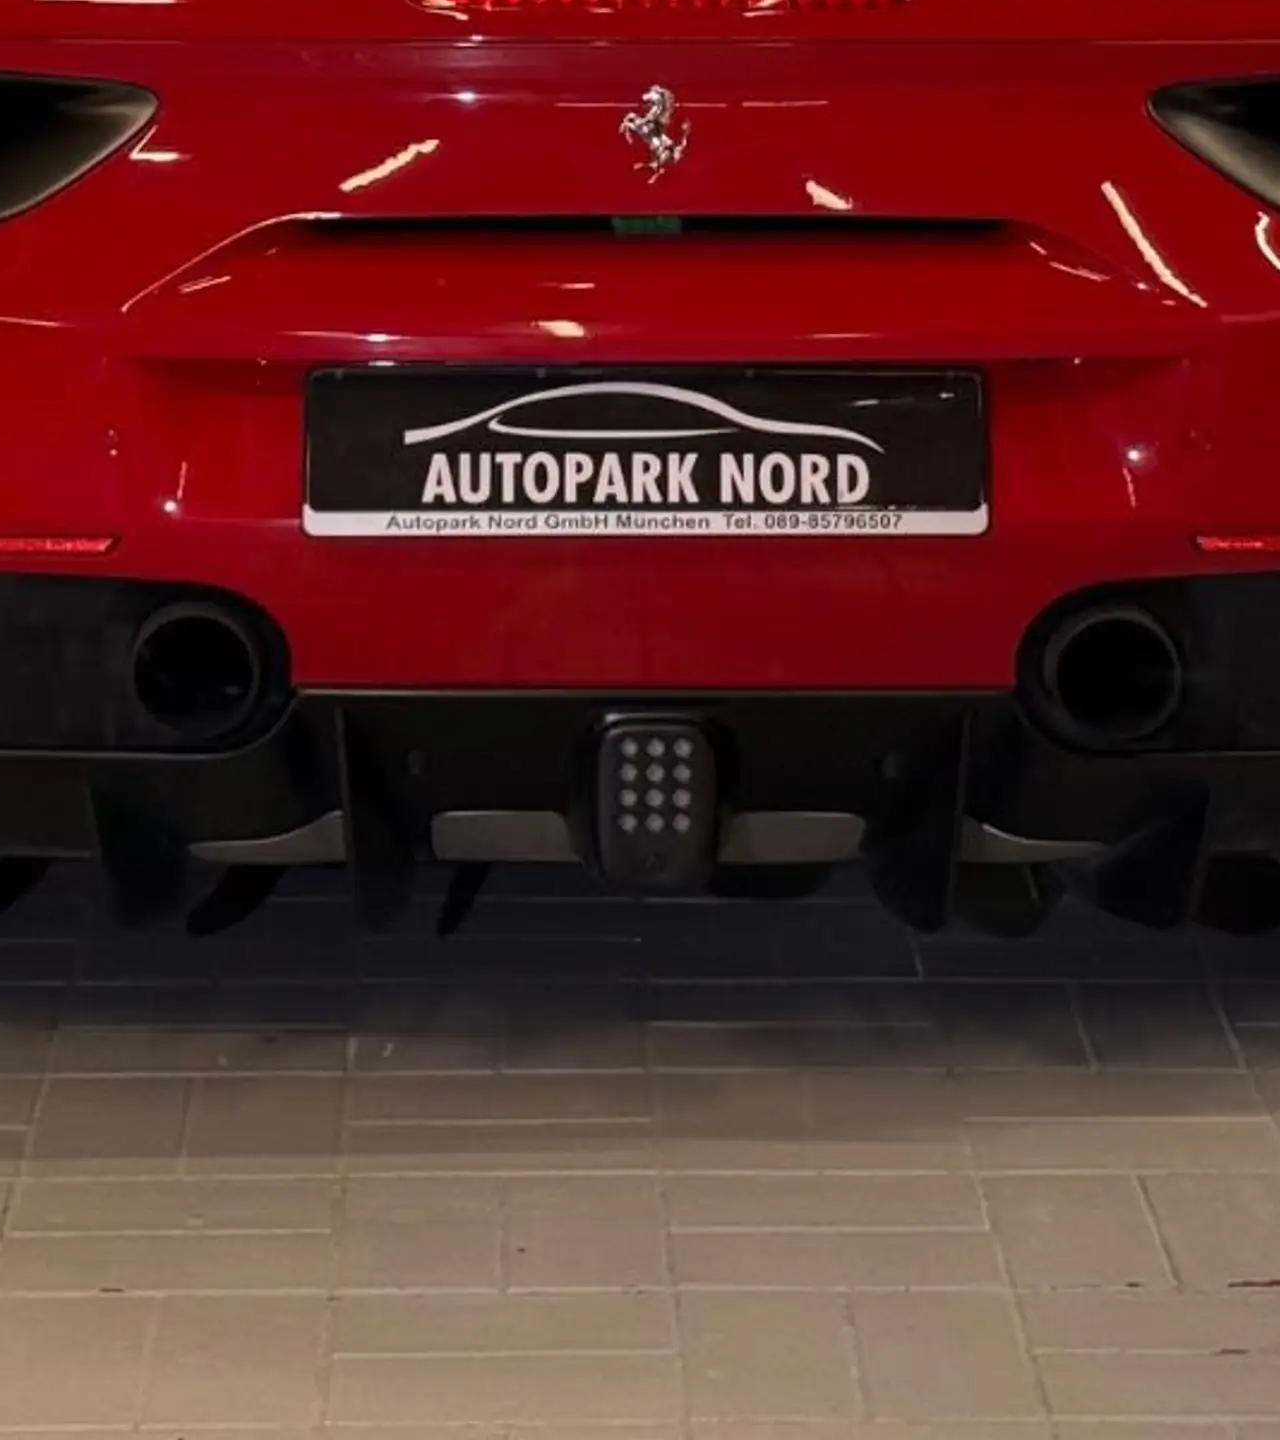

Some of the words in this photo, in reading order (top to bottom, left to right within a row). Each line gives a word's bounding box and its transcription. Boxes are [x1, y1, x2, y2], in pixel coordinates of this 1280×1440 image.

[422, 451, 700, 504] AUTOPARK
[719, 451, 870, 504] NORD
[386, 514, 481, 532] Autopark
[488, 514, 538, 530] Nord
[543, 514, 609, 530] GmbH
[615, 513, 711, 530] München
[722, 513, 757, 530] Tel.
[763, 513, 903, 530] 089-85796507
